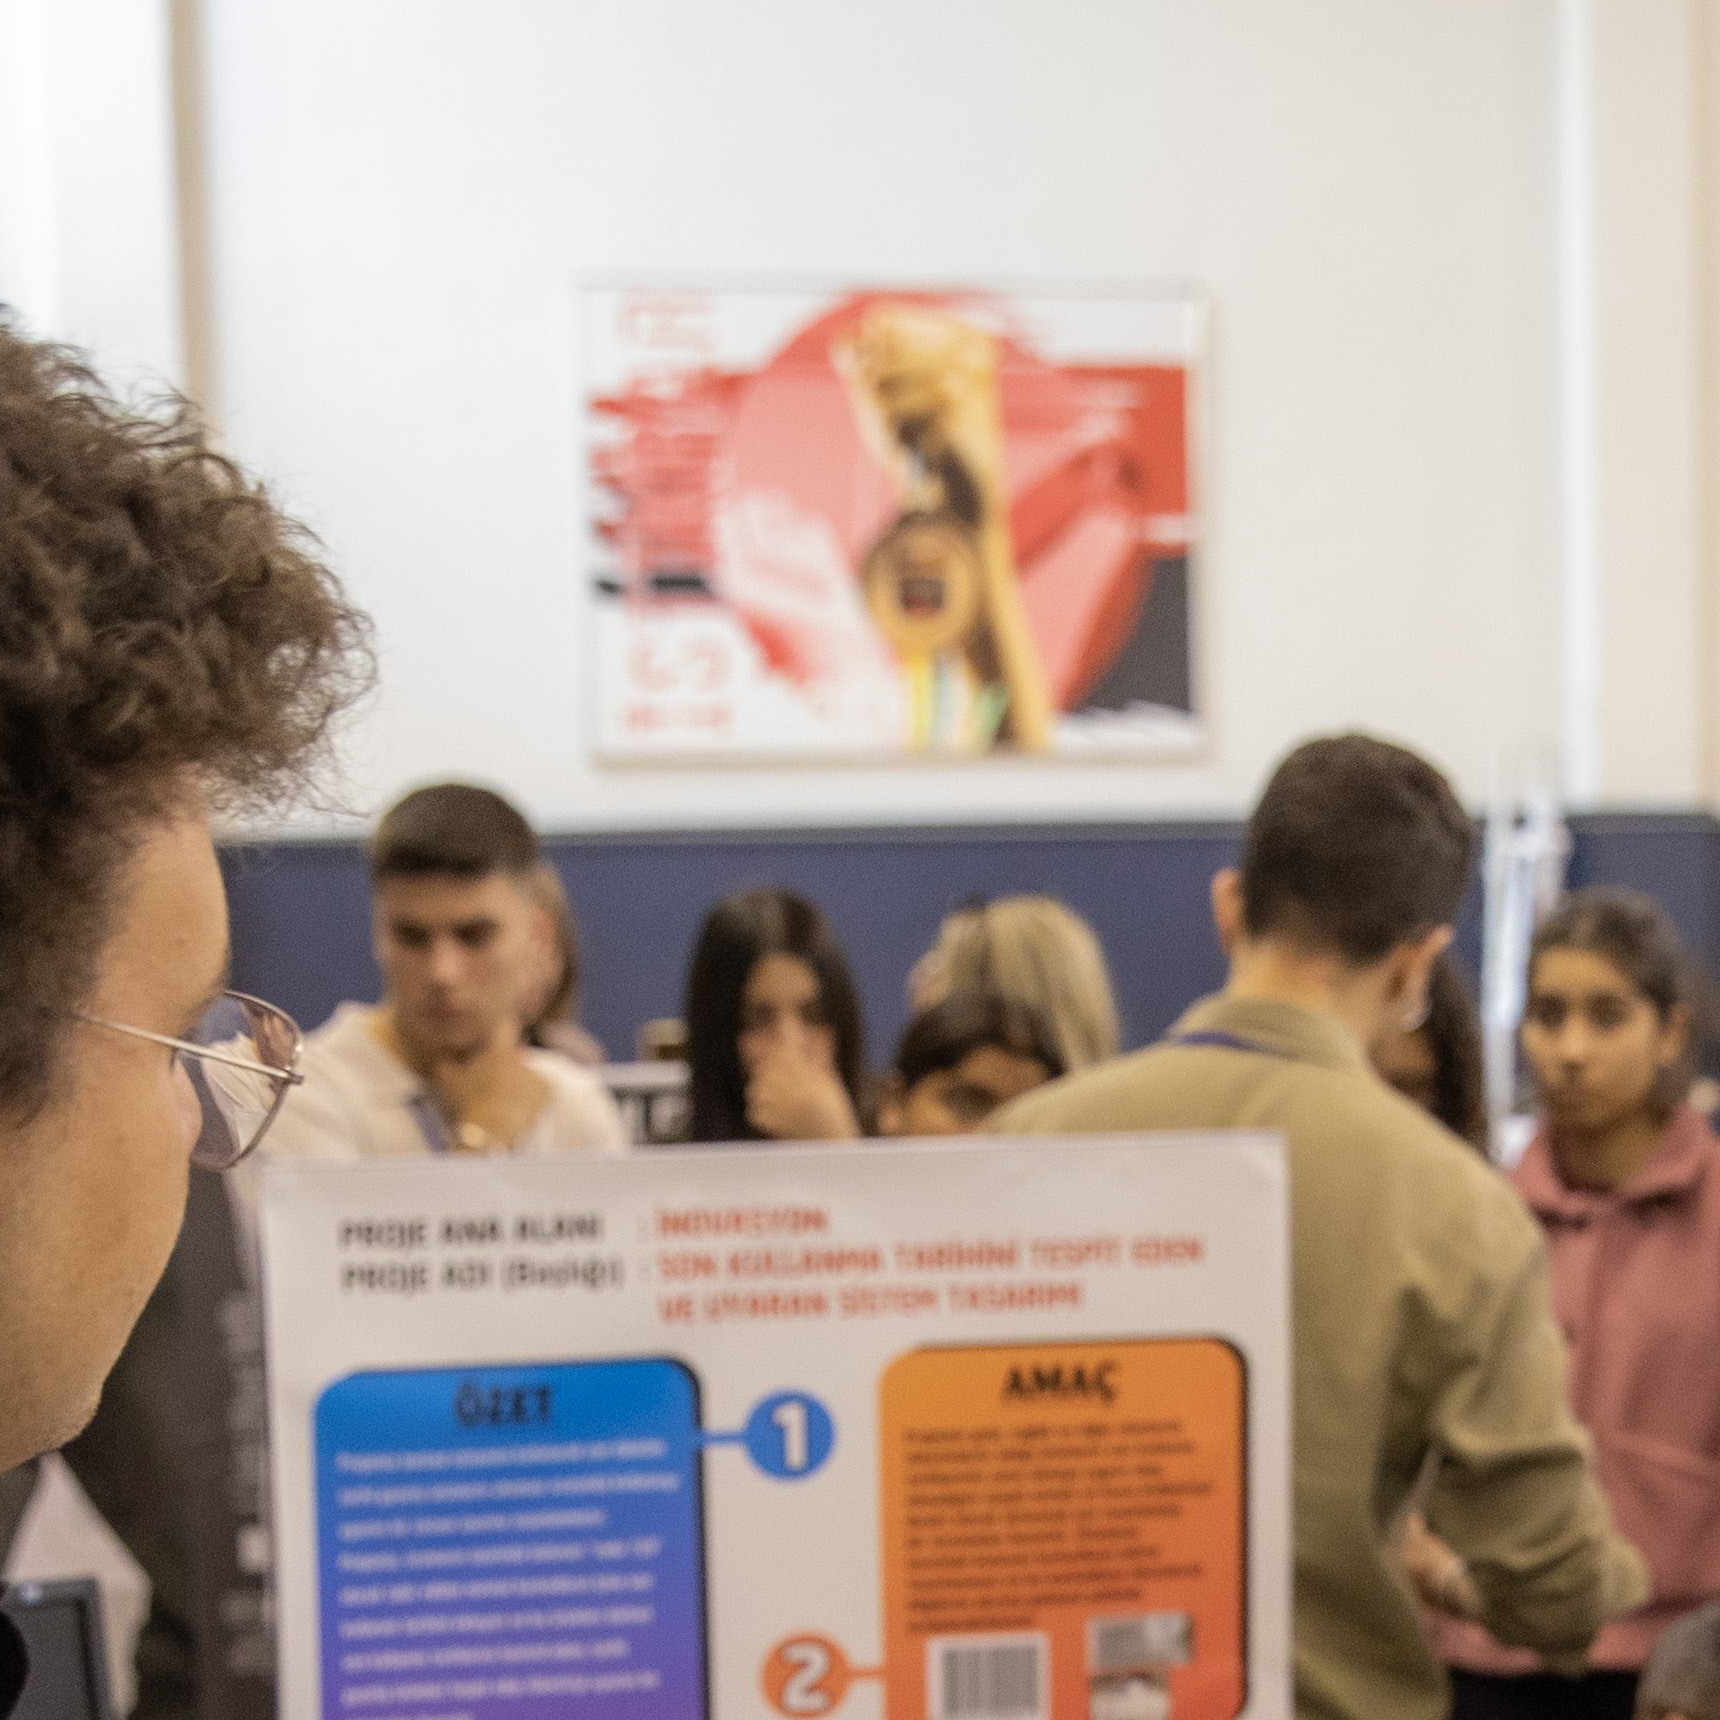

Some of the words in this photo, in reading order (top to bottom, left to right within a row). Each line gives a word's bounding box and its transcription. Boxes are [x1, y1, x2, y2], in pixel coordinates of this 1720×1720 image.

[340, 1219, 427, 1249] PROJE
[341, 1262, 428, 1292] PROJE
[1003, 1362, 1118, 1403] AMAÇ
[453, 1383, 554, 1425] ÖZET
[773, 1405, 808, 1466] 1
[779, 1646, 828, 1712] 2
